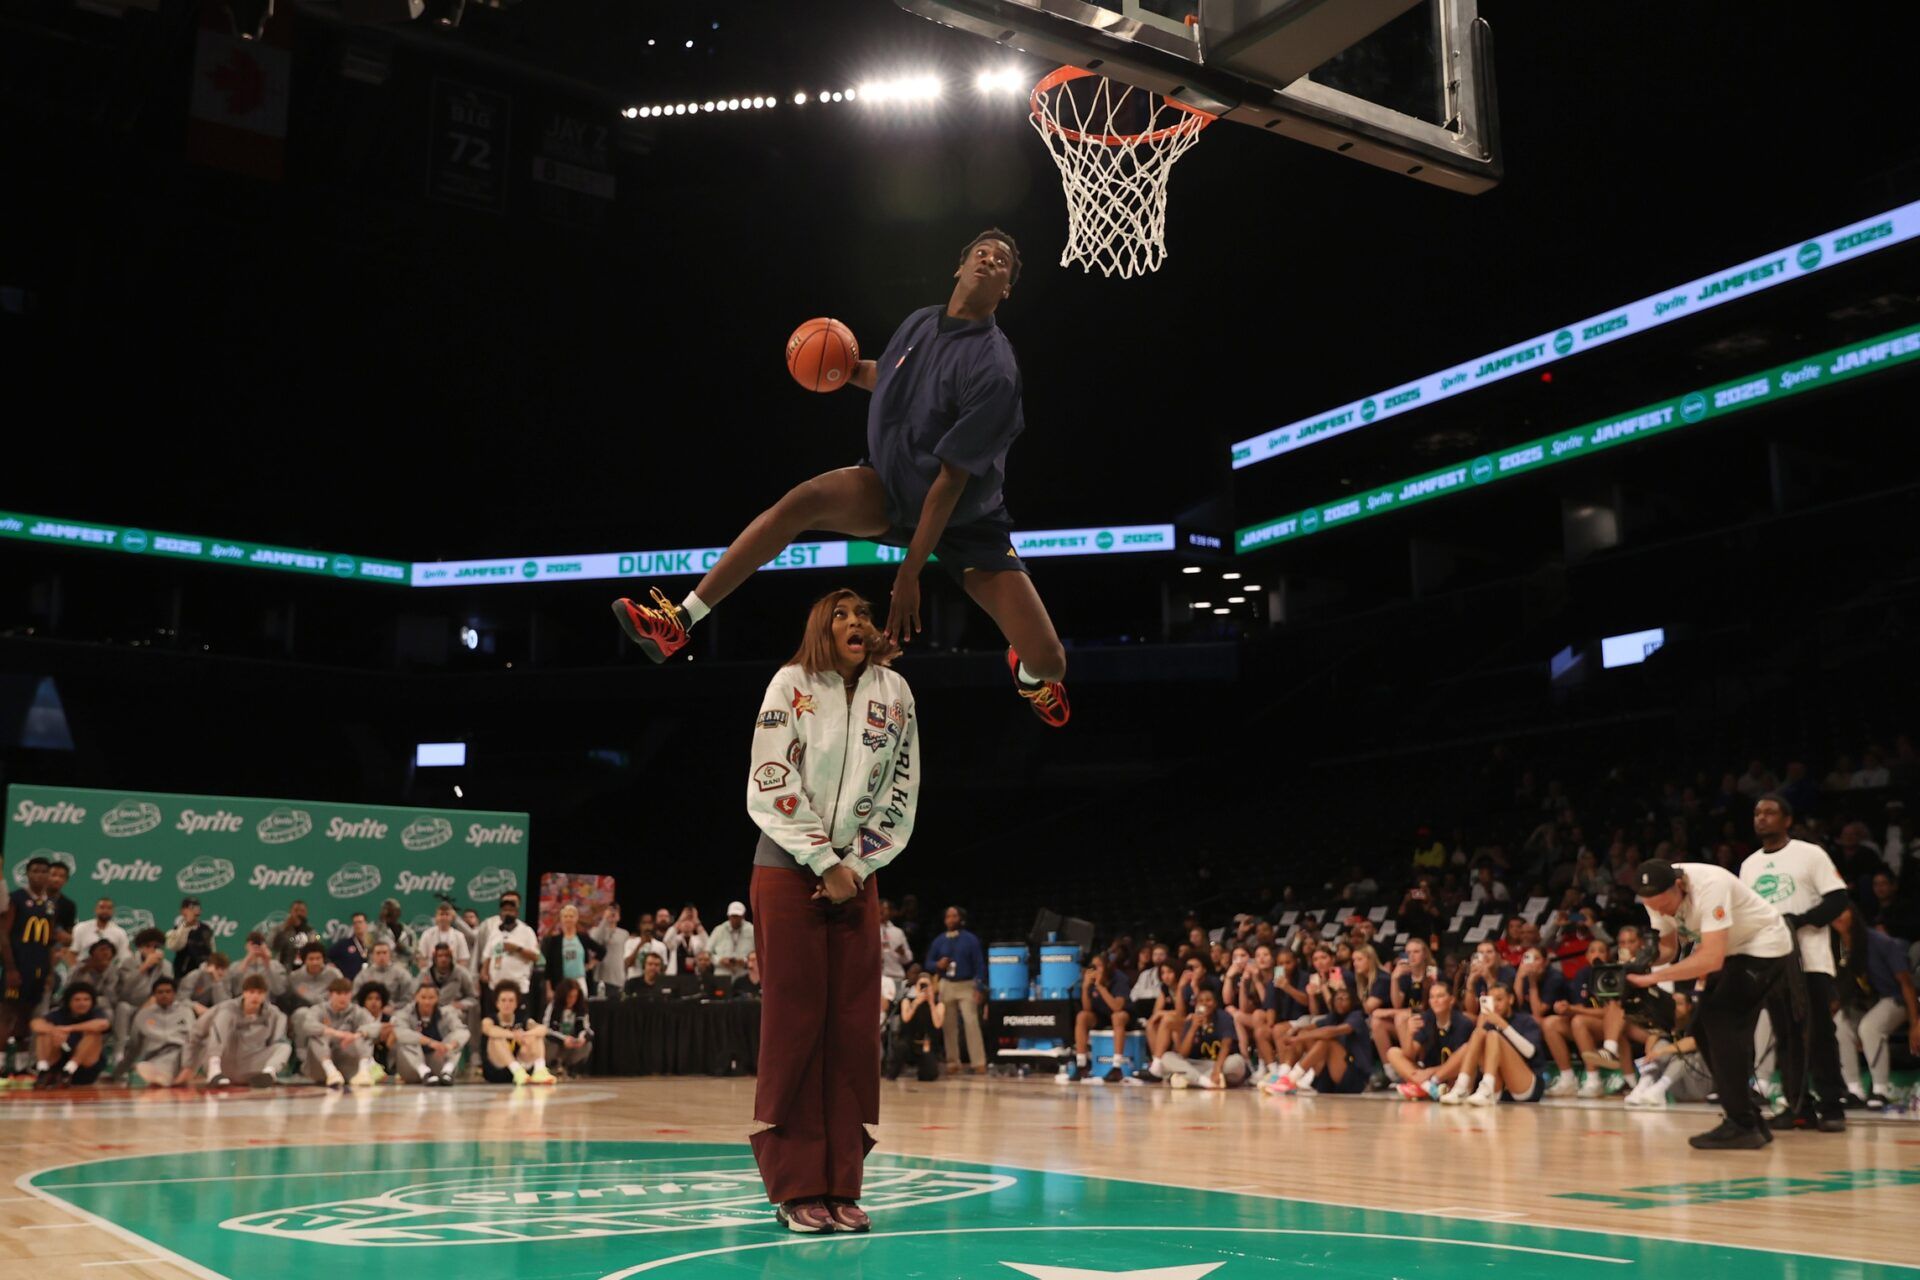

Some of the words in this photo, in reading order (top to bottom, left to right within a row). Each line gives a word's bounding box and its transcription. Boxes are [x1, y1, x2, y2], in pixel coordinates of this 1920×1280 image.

[448, 131, 492, 171] 72
[1296, 410, 1354, 440] JAMFEST
[1475, 342, 1546, 378] JAMFEST
[1582, 314, 1629, 341] 2025
[1653, 294, 1688, 316] Sprite
[1697, 257, 1787, 301] JAMFEST
[1833, 219, 1894, 254] 2025
[1398, 467, 1468, 501] JAMFEST
[1499, 445, 1544, 471] 2025
[1550, 434, 1585, 456] Sprite
[1590, 406, 1675, 445] JAMFEST
[1714, 377, 1771, 409] 2025
[1779, 364, 1822, 390] Sprite
[1830, 331, 1920, 375] JAMFES
[1019, 535, 1088, 549] JAMFEST
[1122, 532, 1164, 545] 2025
[250, 549, 328, 570] JAMFEST
[454, 565, 516, 578] JAMFEST
[618, 551, 693, 574] DUNK
[702, 545, 822, 570] CEST
[763, 777, 781, 786] KANI
[13, 800, 87, 827] Sprite
[176, 809, 243, 835] Sprite
[325, 816, 388, 842] Sprite
[465, 823, 524, 848] Sprite
[92, 858, 163, 885] Sprite
[249, 864, 314, 890] Sprite
[395, 870, 455, 895] Sprite
[451, 1180, 747, 1204] Sprite
